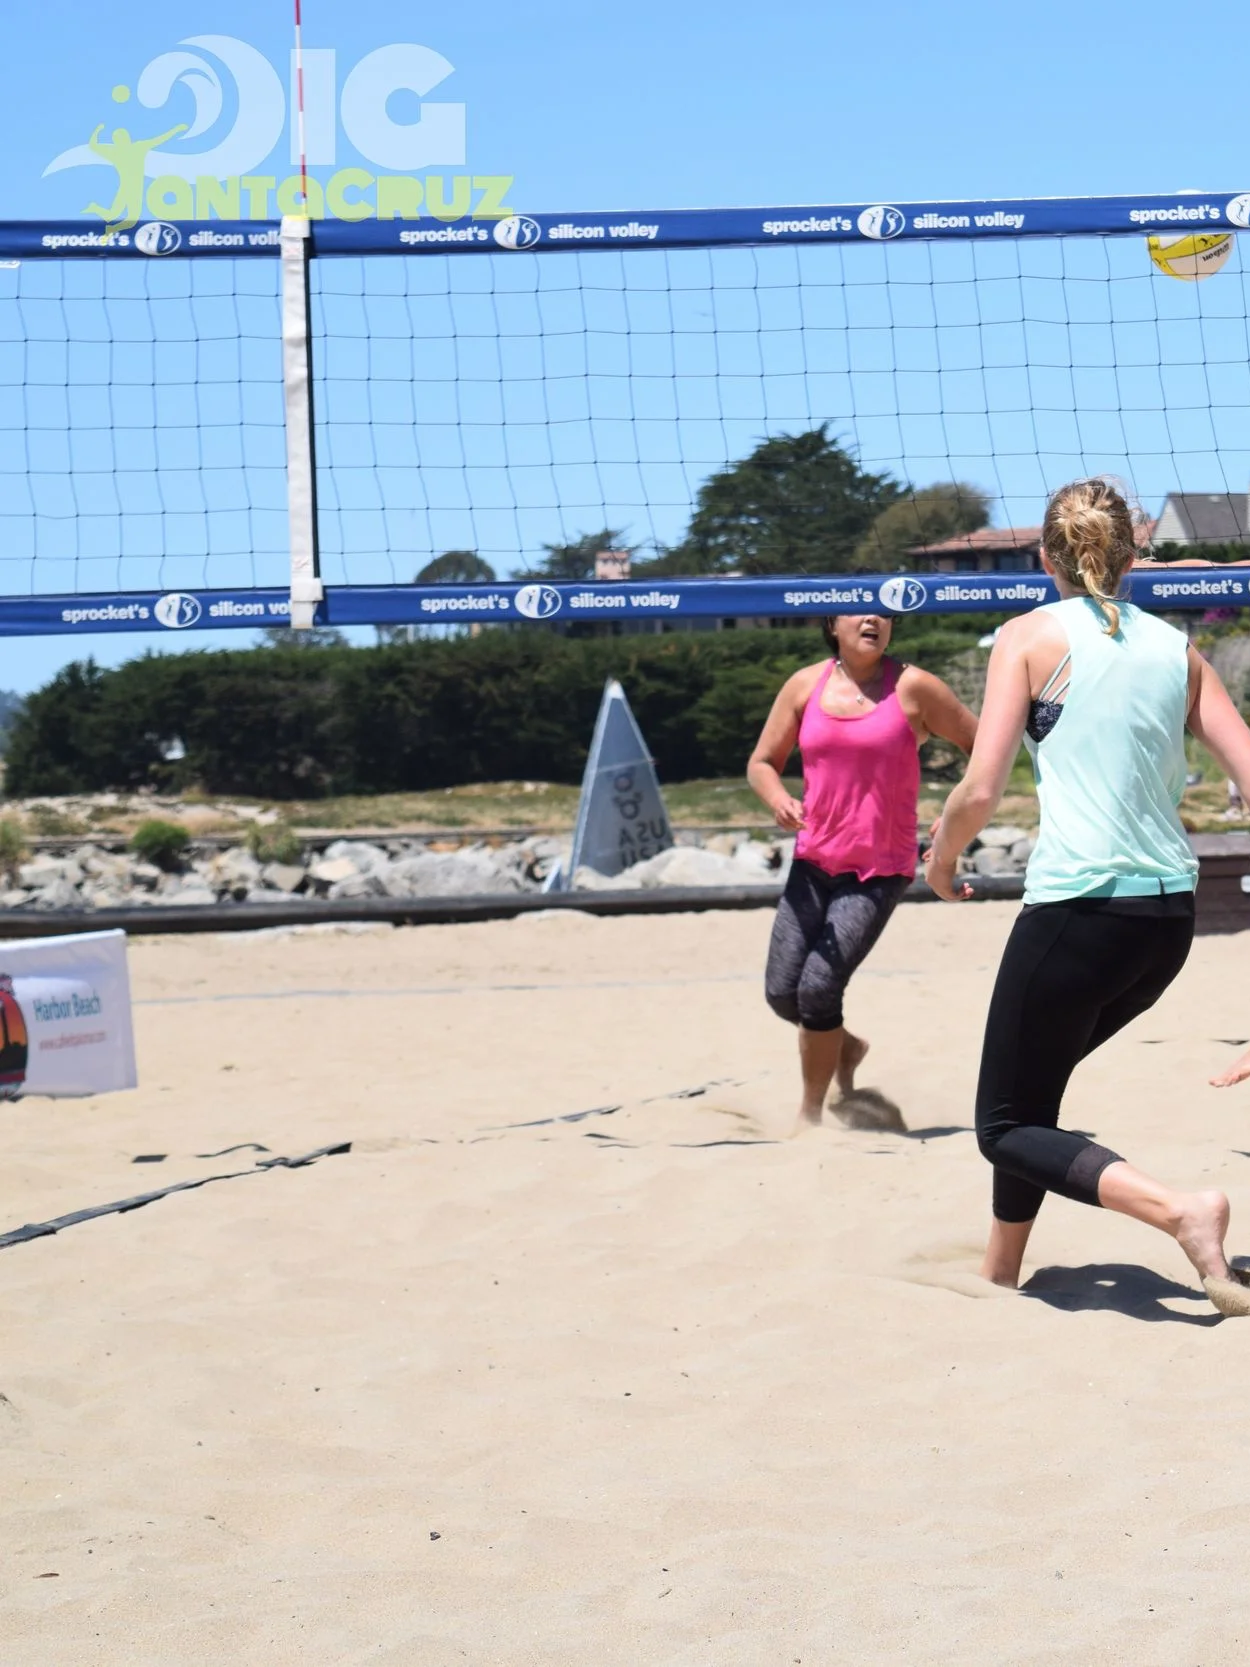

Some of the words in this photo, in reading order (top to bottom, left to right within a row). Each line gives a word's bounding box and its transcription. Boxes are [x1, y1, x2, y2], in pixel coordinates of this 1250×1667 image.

[763, 216, 852, 235] sprocket's
[913, 214, 970, 228] silicon
[974, 212, 1024, 228] volley
[1130, 205, 1220, 224] sprocket's
[42, 232, 129, 249] sprocket's
[189, 231, 244, 246] silicon
[248, 230, 281, 245] voll
[400, 227, 488, 244] sprocket's
[549, 224, 604, 239] silicon
[609, 223, 659, 239] volley
[784, 588, 873, 606] sprocket's
[936, 586, 991, 601] silicon
[996, 584, 1046, 601] volley
[1153, 579, 1243, 598] sprocket's
[62, 604, 149, 623] sprocket's
[209, 601, 264, 616] silicon
[268, 600, 291, 615] vol
[421, 595, 509, 613] sprocket's
[570, 593, 625, 608] silicon
[630, 592, 680, 609] volley
[33, 995, 71, 1021] Harbor
[72, 989, 102, 1017] Beach
